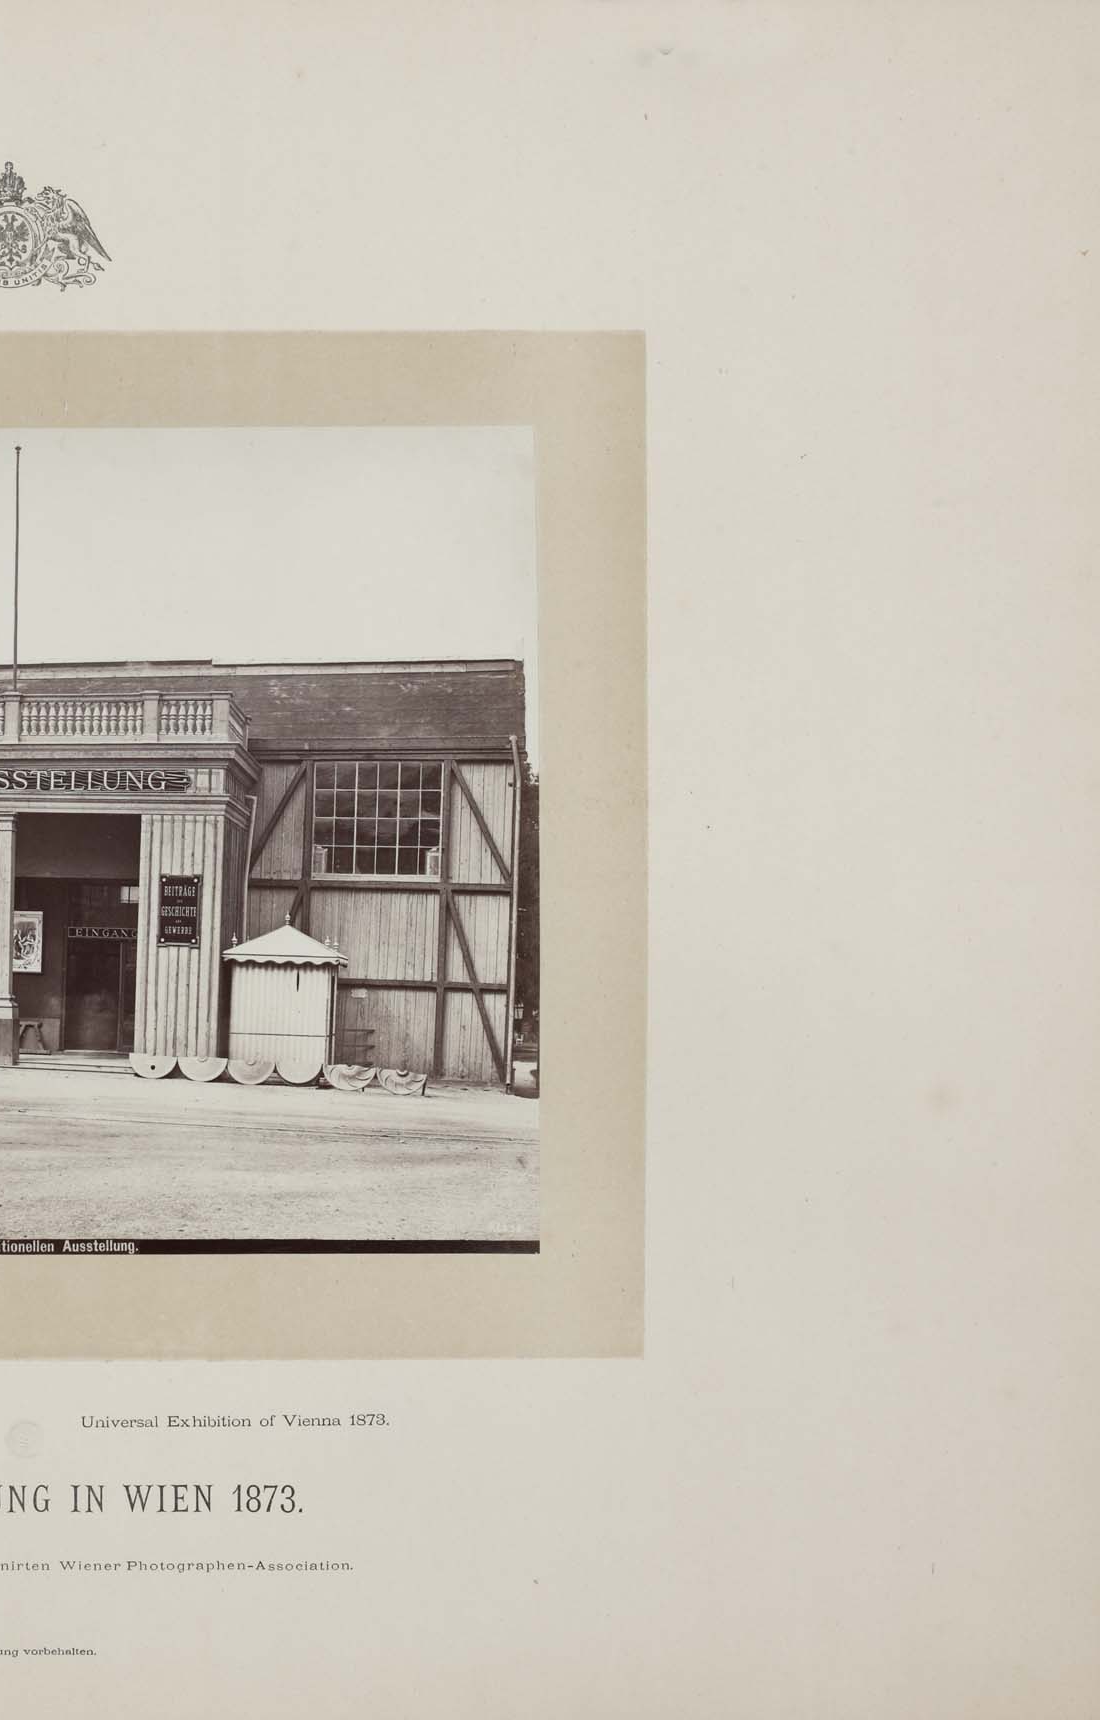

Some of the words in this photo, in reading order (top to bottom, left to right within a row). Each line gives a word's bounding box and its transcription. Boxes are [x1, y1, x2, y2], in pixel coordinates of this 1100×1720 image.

[14, 263, 48, 285] UNITIS
[81, 1415, 159, 1429] Universal
[166, 1415, 252, 1429] Exhibition
[259, 1414, 277, 1428] of
[281, 1414, 342, 1428] Vienna
[349, 1413, 390, 1427] 1873.
[69, 1484, 105, 1513] IN
[122, 1483, 214, 1513] WIEN
[231, 1483, 304, 1514] 1873.
[59, 1560, 122, 1572] Wiener
[126, 1560, 354, 1574] Photographen-Association.
[22, 1647, 97, 1657] vorbehalten.
